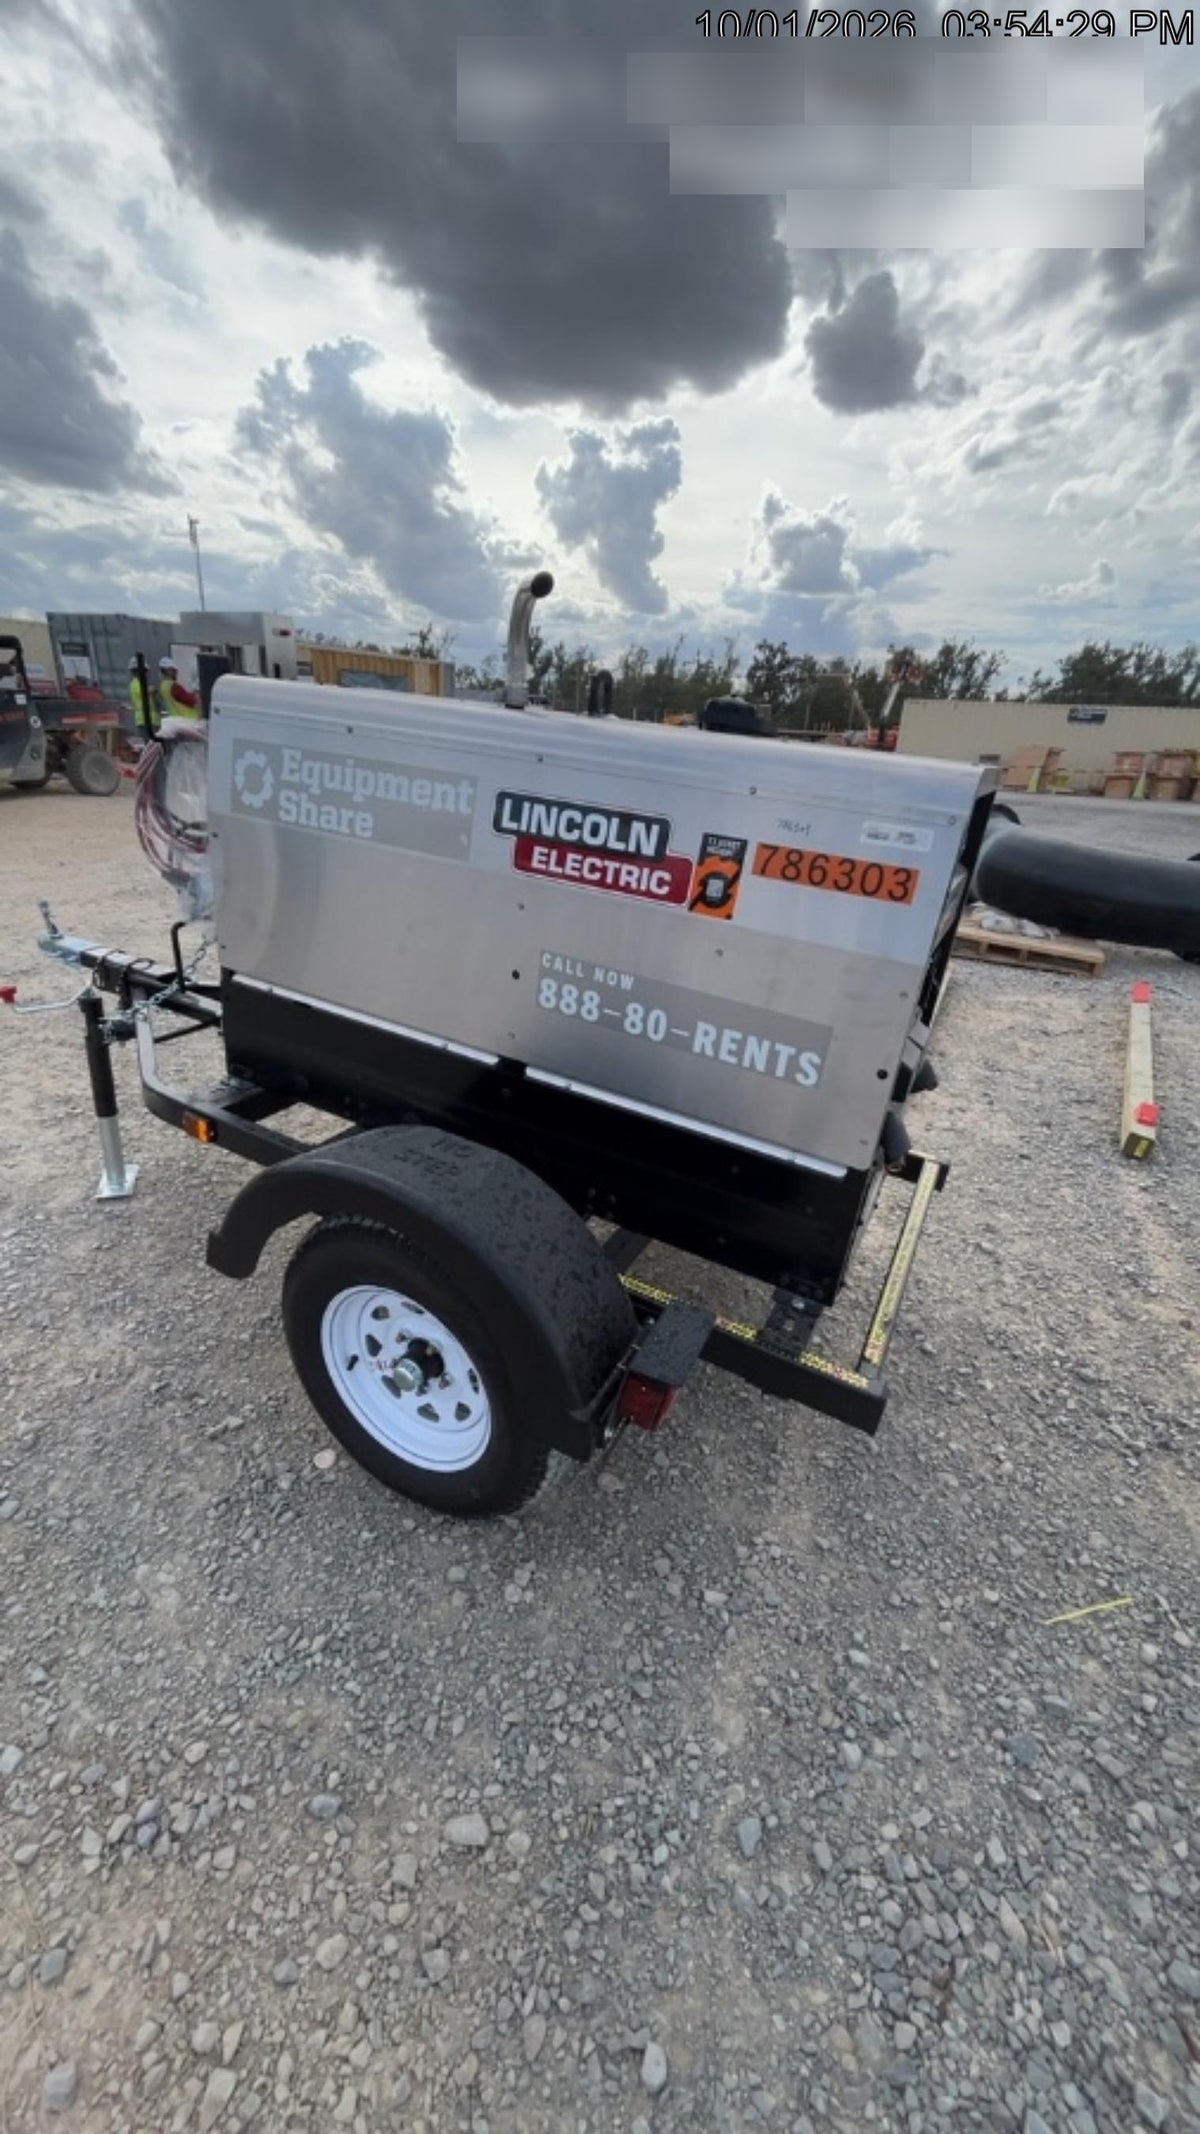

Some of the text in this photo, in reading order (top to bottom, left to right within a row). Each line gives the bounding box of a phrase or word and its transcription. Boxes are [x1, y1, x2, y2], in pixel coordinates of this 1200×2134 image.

[280, 749, 474, 815] Equipment
[278, 789, 373, 838] Share
[501, 799, 660, 857] LINCOLN
[531, 846, 672, 895] ELECTRIC
[759, 844, 912, 901] 786303
[541, 952, 635, 991] CALL NOW
[538, 978, 822, 1088] 888-80-RENTS
